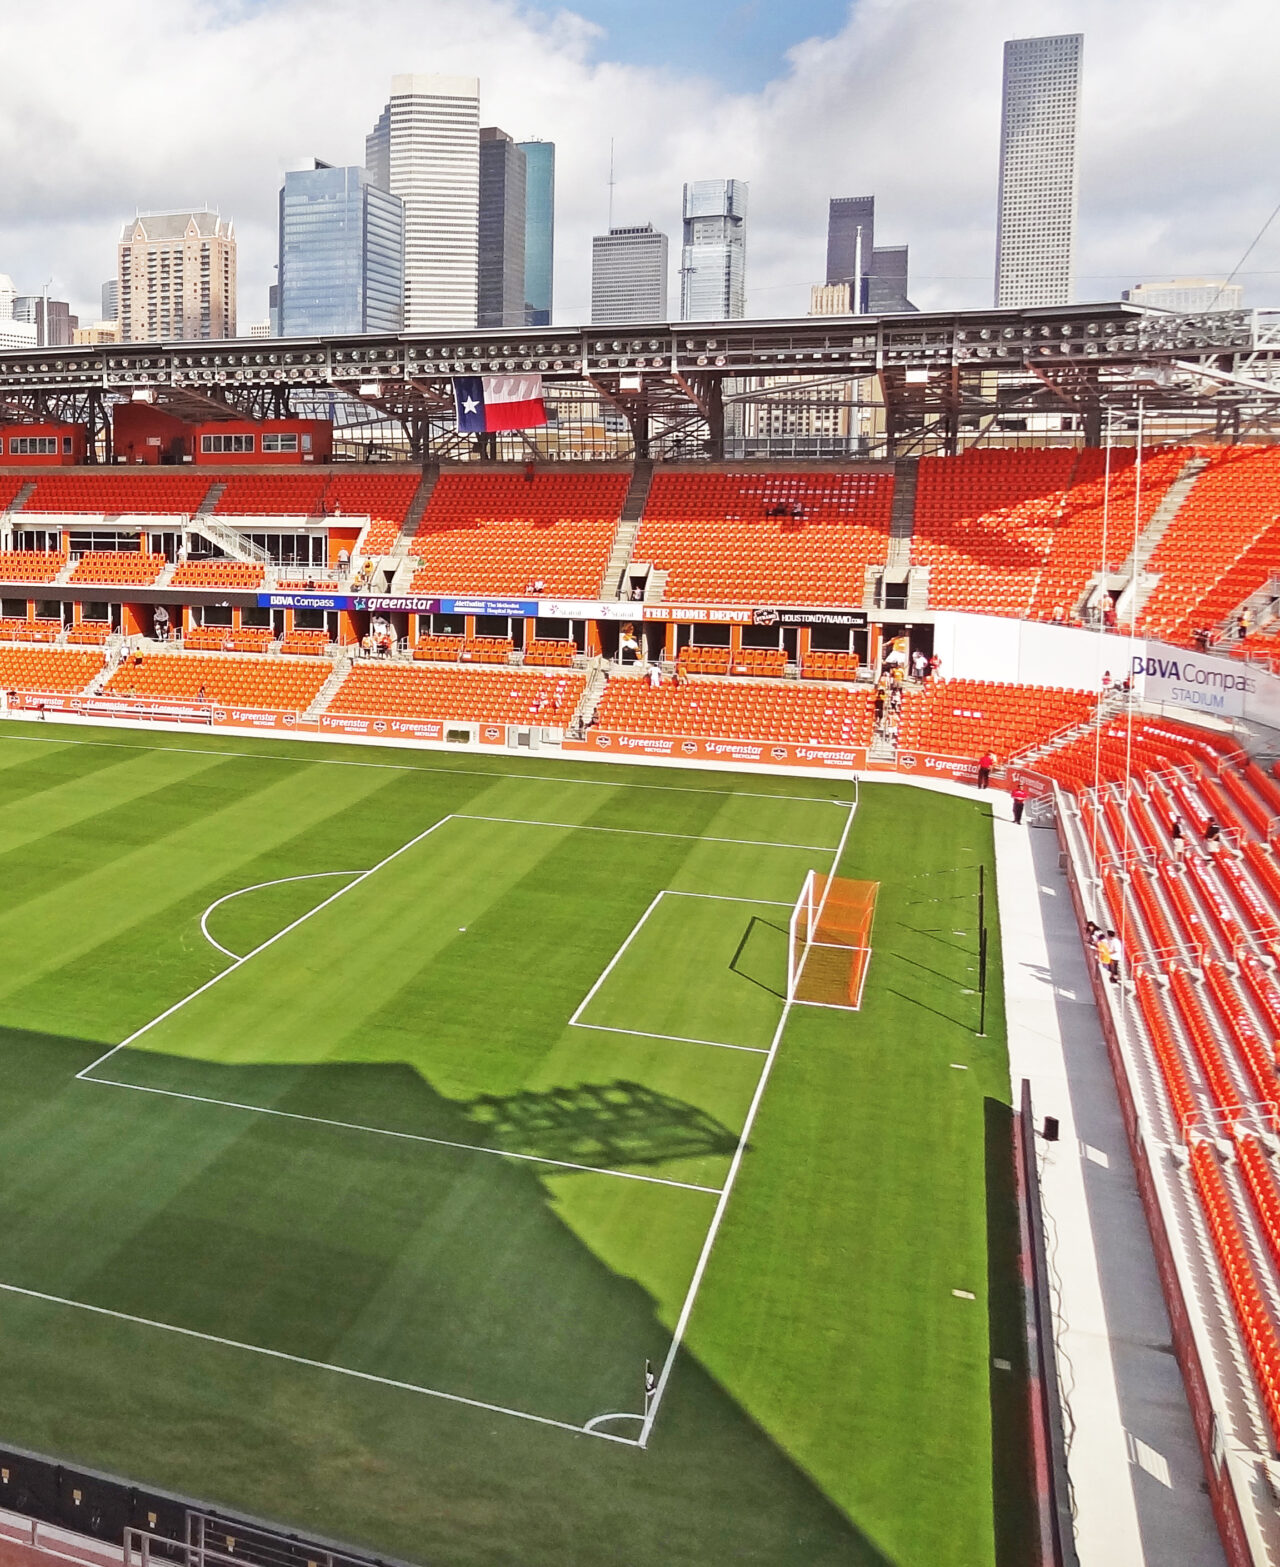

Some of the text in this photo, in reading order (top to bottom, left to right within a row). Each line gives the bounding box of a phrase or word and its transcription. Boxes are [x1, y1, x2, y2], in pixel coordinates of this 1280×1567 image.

[270, 596, 335, 608] BBVA Compass
[368, 598, 433, 611] greenstar
[644, 608, 670, 618] THE
[672, 609, 707, 620] HOME
[709, 610, 751, 622] DEPOT
[1132, 656, 1181, 681] BBVA
[1171, 688, 1225, 708] STADIUM
[240, 712, 278, 722] greenstar
[330, 718, 370, 728] greenstar
[400, 723, 440, 734] greenstar
[628, 738, 674, 748] greenstar
[716, 742, 763, 754] greenstar
[806, 750, 856, 761] greenstar
